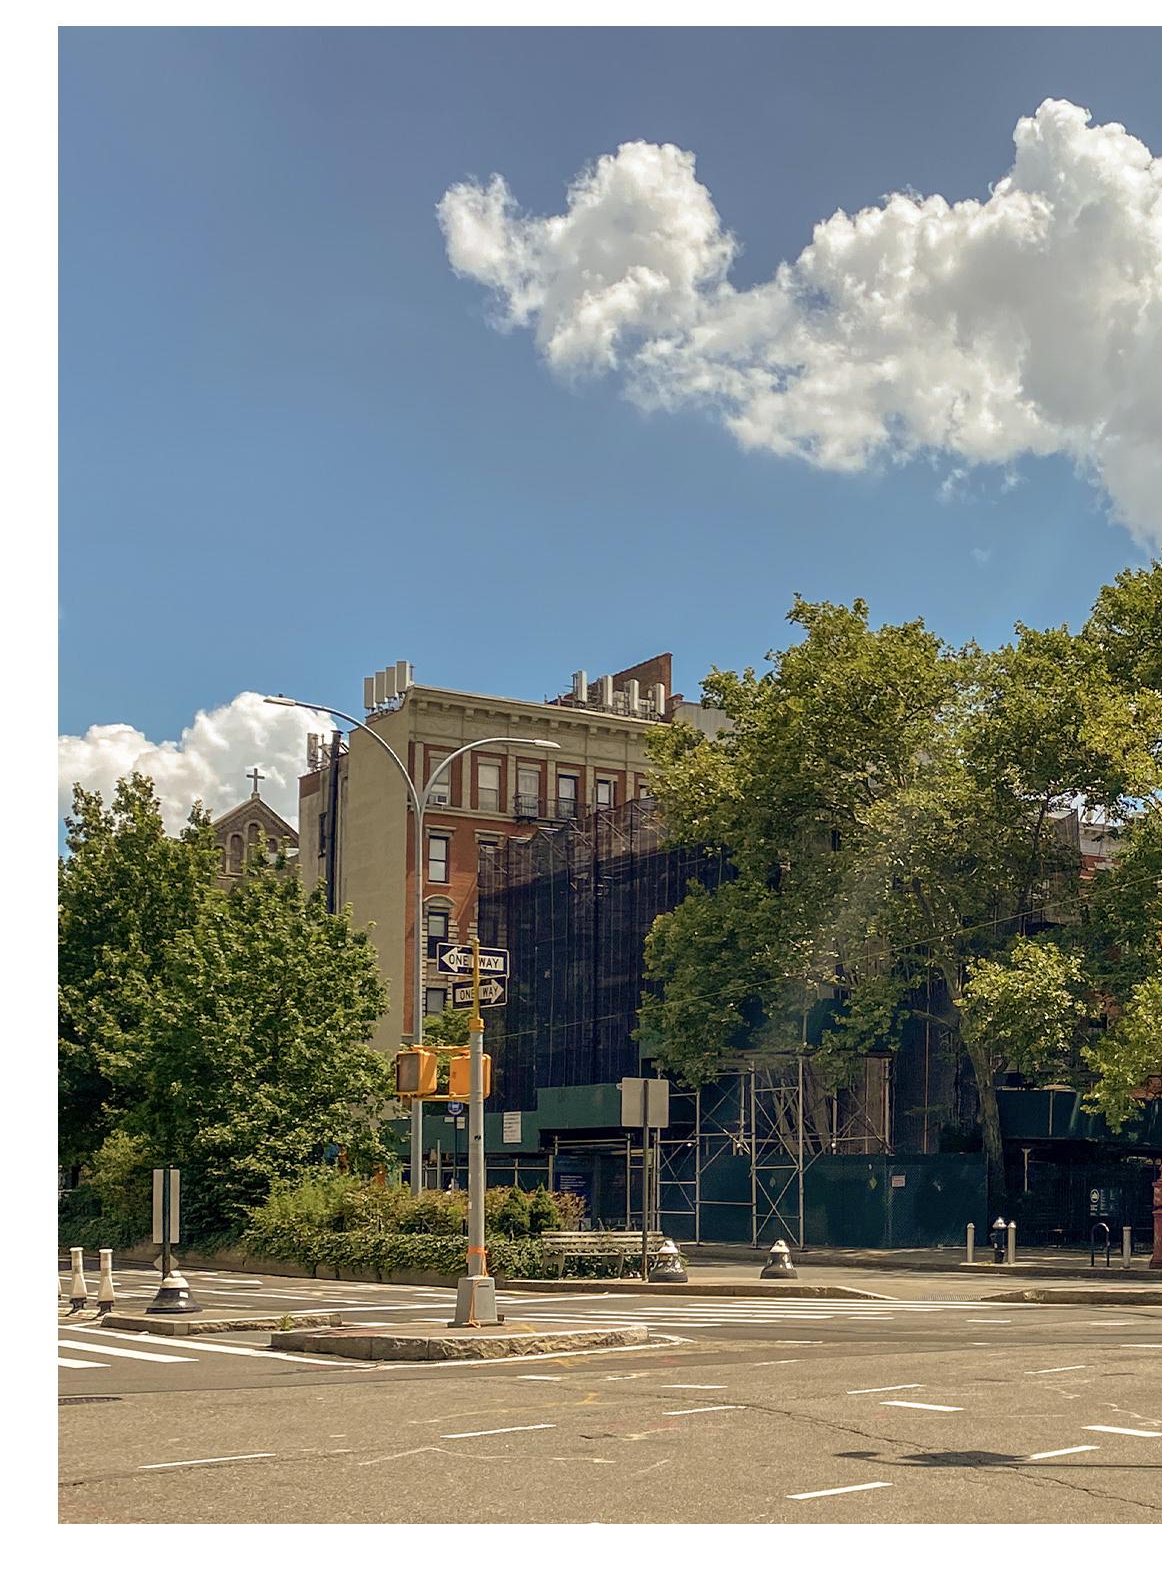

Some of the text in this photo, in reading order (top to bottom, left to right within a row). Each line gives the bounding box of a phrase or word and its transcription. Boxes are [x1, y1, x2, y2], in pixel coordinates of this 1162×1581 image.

[448, 953, 499, 969] ONE WAY
[482, 984, 498, 999] WAY
